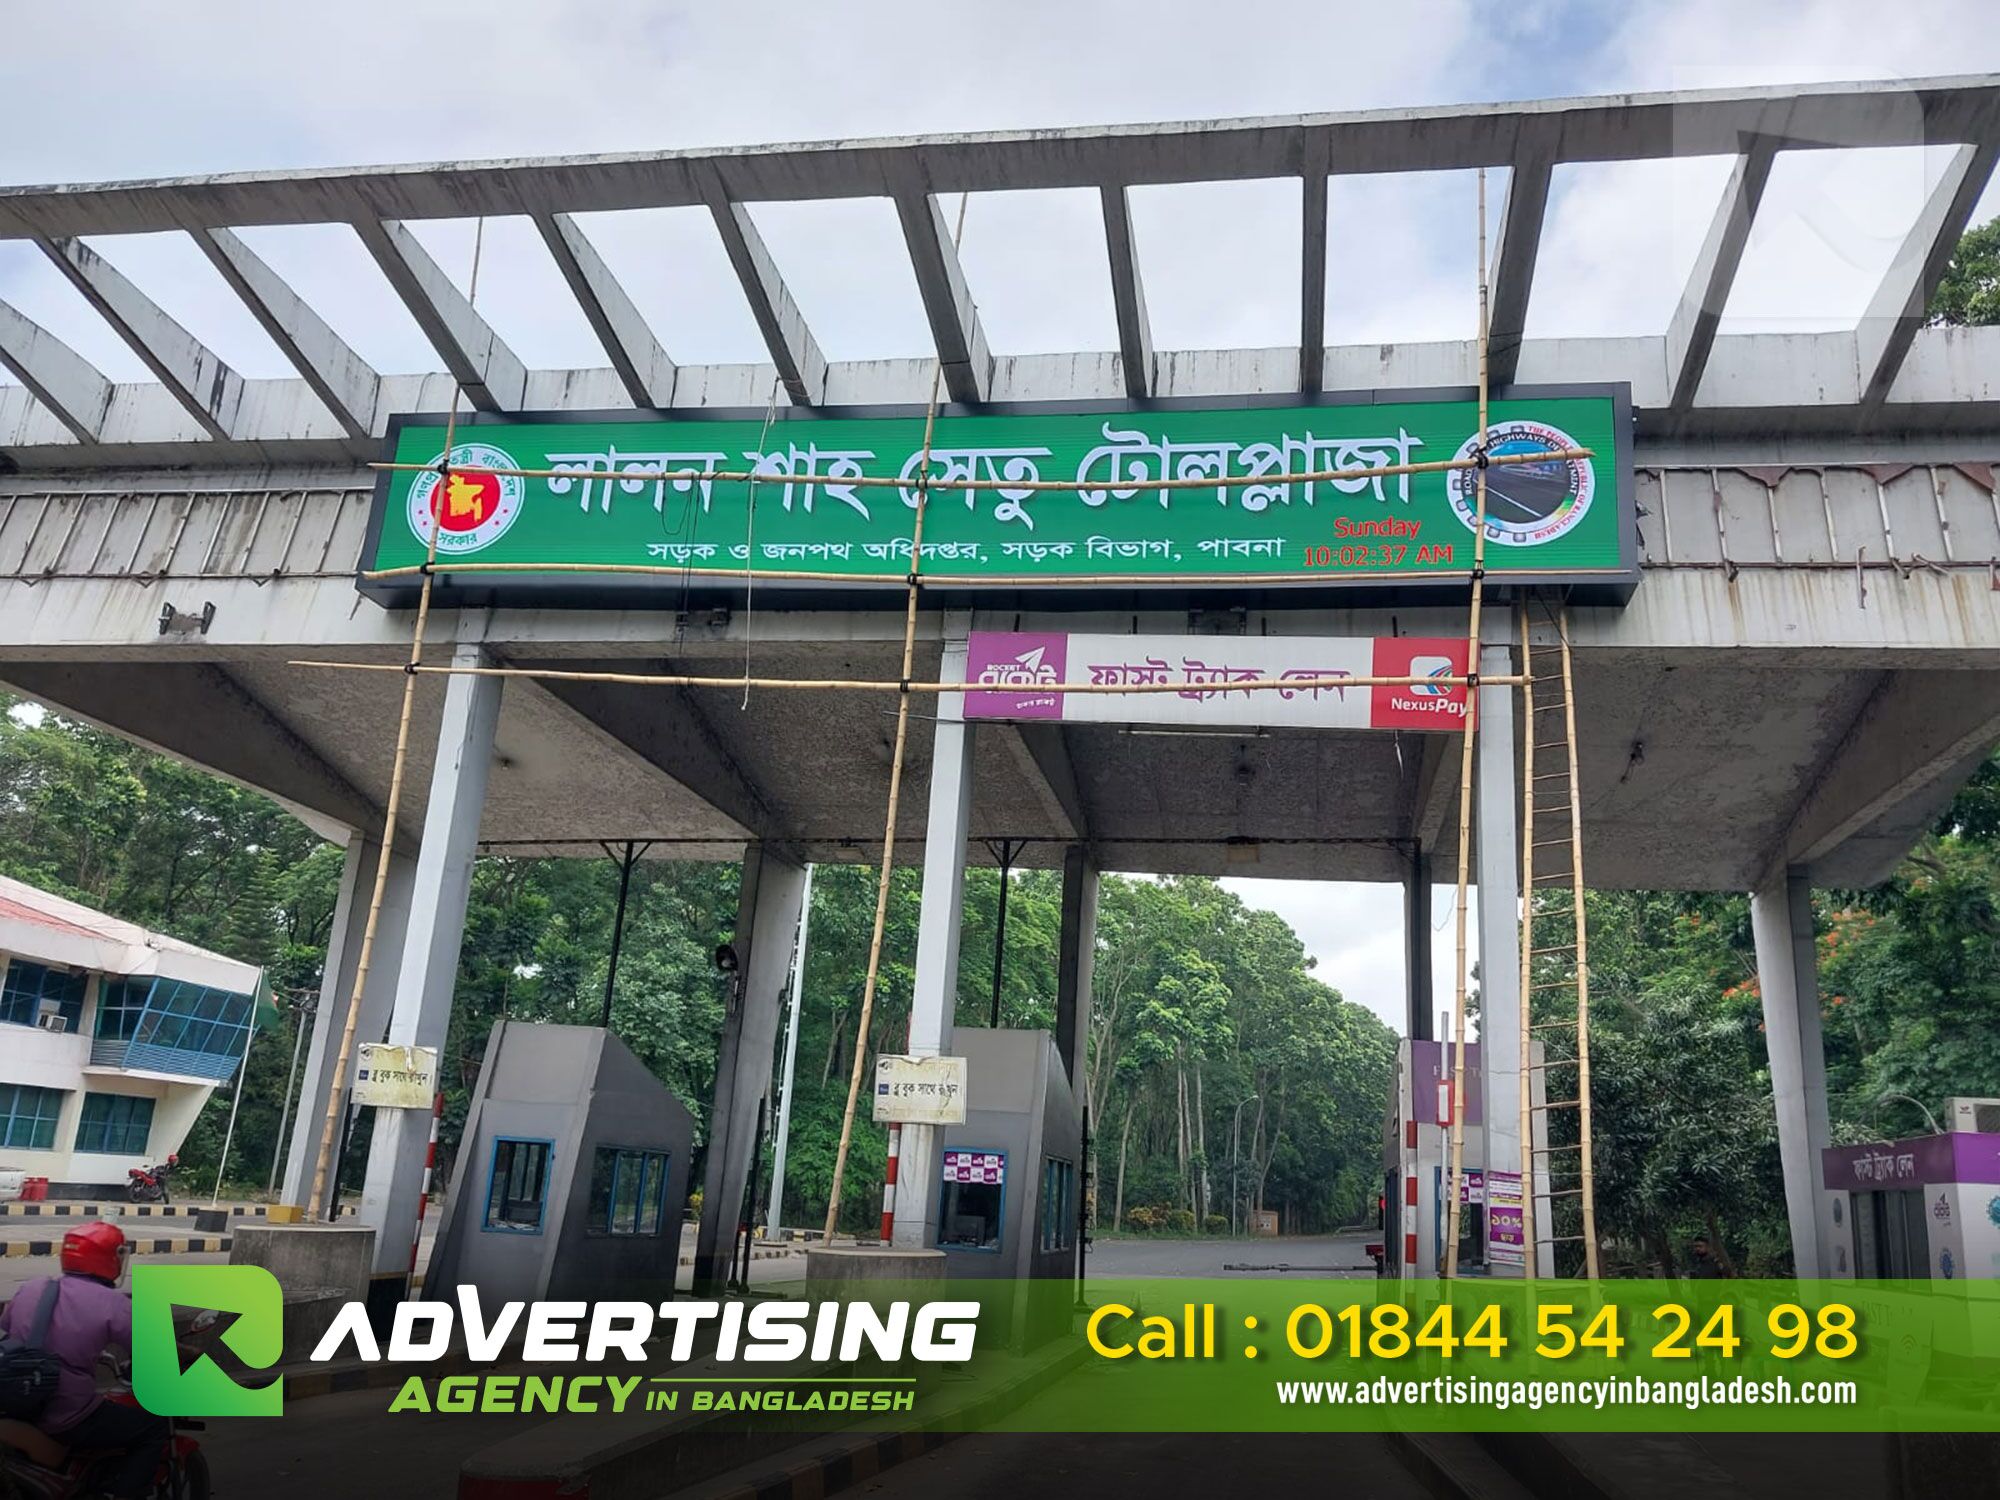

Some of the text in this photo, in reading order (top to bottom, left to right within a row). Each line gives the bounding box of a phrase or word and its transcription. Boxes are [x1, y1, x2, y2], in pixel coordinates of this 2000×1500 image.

[1489, 432, 1546, 448] HIGHWAYS
[544, 421, 1425, 531] লালন শাহ সেতু টোলপ্লাজা
[1334, 515, 1421, 540] Sunday
[646, 543, 718, 564] সড়ক
[728, 544, 751, 560] ও
[761, 542, 852, 561] জনপথ
[1000, 540, 1076, 563] সড়ক
[1084, 535, 1183, 562] বিভাগ,
[1197, 536, 1287, 558] পাবনা
[1304, 543, 1453, 567] 10:02:37 AM
[1391, 697, 1468, 718] NexusPay
